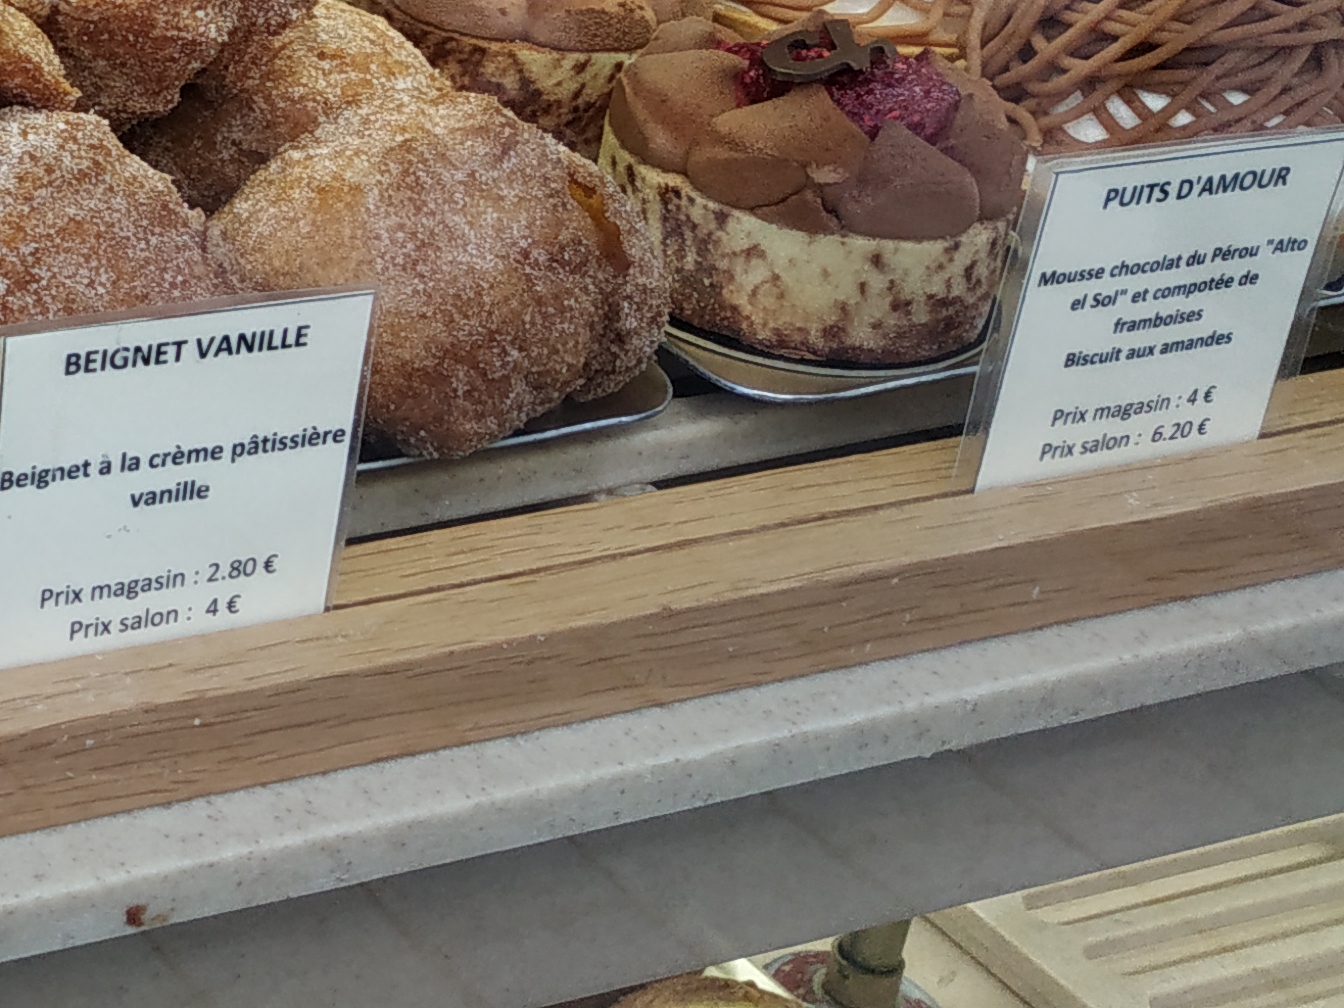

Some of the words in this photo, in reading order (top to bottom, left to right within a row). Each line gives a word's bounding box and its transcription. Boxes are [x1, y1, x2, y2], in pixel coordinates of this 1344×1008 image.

[1103, 182, 1170, 210] PUITS
[1176, 167, 1291, 199] D'AMOUR
[1038, 268, 1104, 287] Mousse
[1109, 254, 1182, 278] chocolat
[1186, 251, 1206, 268] du
[1211, 244, 1260, 264] Pérou
[1266, 237, 1308, 255] "Alto
[1070, 295, 1086, 311] el
[1090, 288, 1127, 309] Sol"
[1131, 288, 1149, 303] et
[1153, 277, 1234, 303] compotée
[1238, 270, 1260, 286] de
[1112, 307, 1204, 334] framboises
[64, 340, 188, 375] BEIGNET
[197, 325, 311, 360] VANILLE
[1064, 346, 1121, 368] Biscuit
[1125, 346, 1156, 361] aux
[1159, 331, 1233, 356] amandes
[1050, 409, 1088, 427] Prix
[1092, 397, 1170, 423] magasin
[1186, 390, 1198, 406] 4
[1202, 386, 1217, 403] €
[0, 459, 91, 491] Beignet
[98, 453, 112, 475] à
[120, 452, 141, 473] la
[149, 444, 224, 470] crème
[231, 427, 346, 463] pâtissière
[1039, 443, 1074, 462] Prix
[1080, 435, 1130, 455] salon
[1151, 421, 1193, 443] 6.20
[1197, 418, 1211, 435] €
[130, 481, 210, 508] vanille
[40, 586, 83, 609] Prix
[90, 569, 186, 602] magasin
[206, 558, 257, 584] 2.80
[263, 554, 278, 574] €
[70, 617, 112, 642] Prix
[119, 606, 179, 633] salon
[205, 598, 219, 617] 4
[226, 595, 241, 614] €
